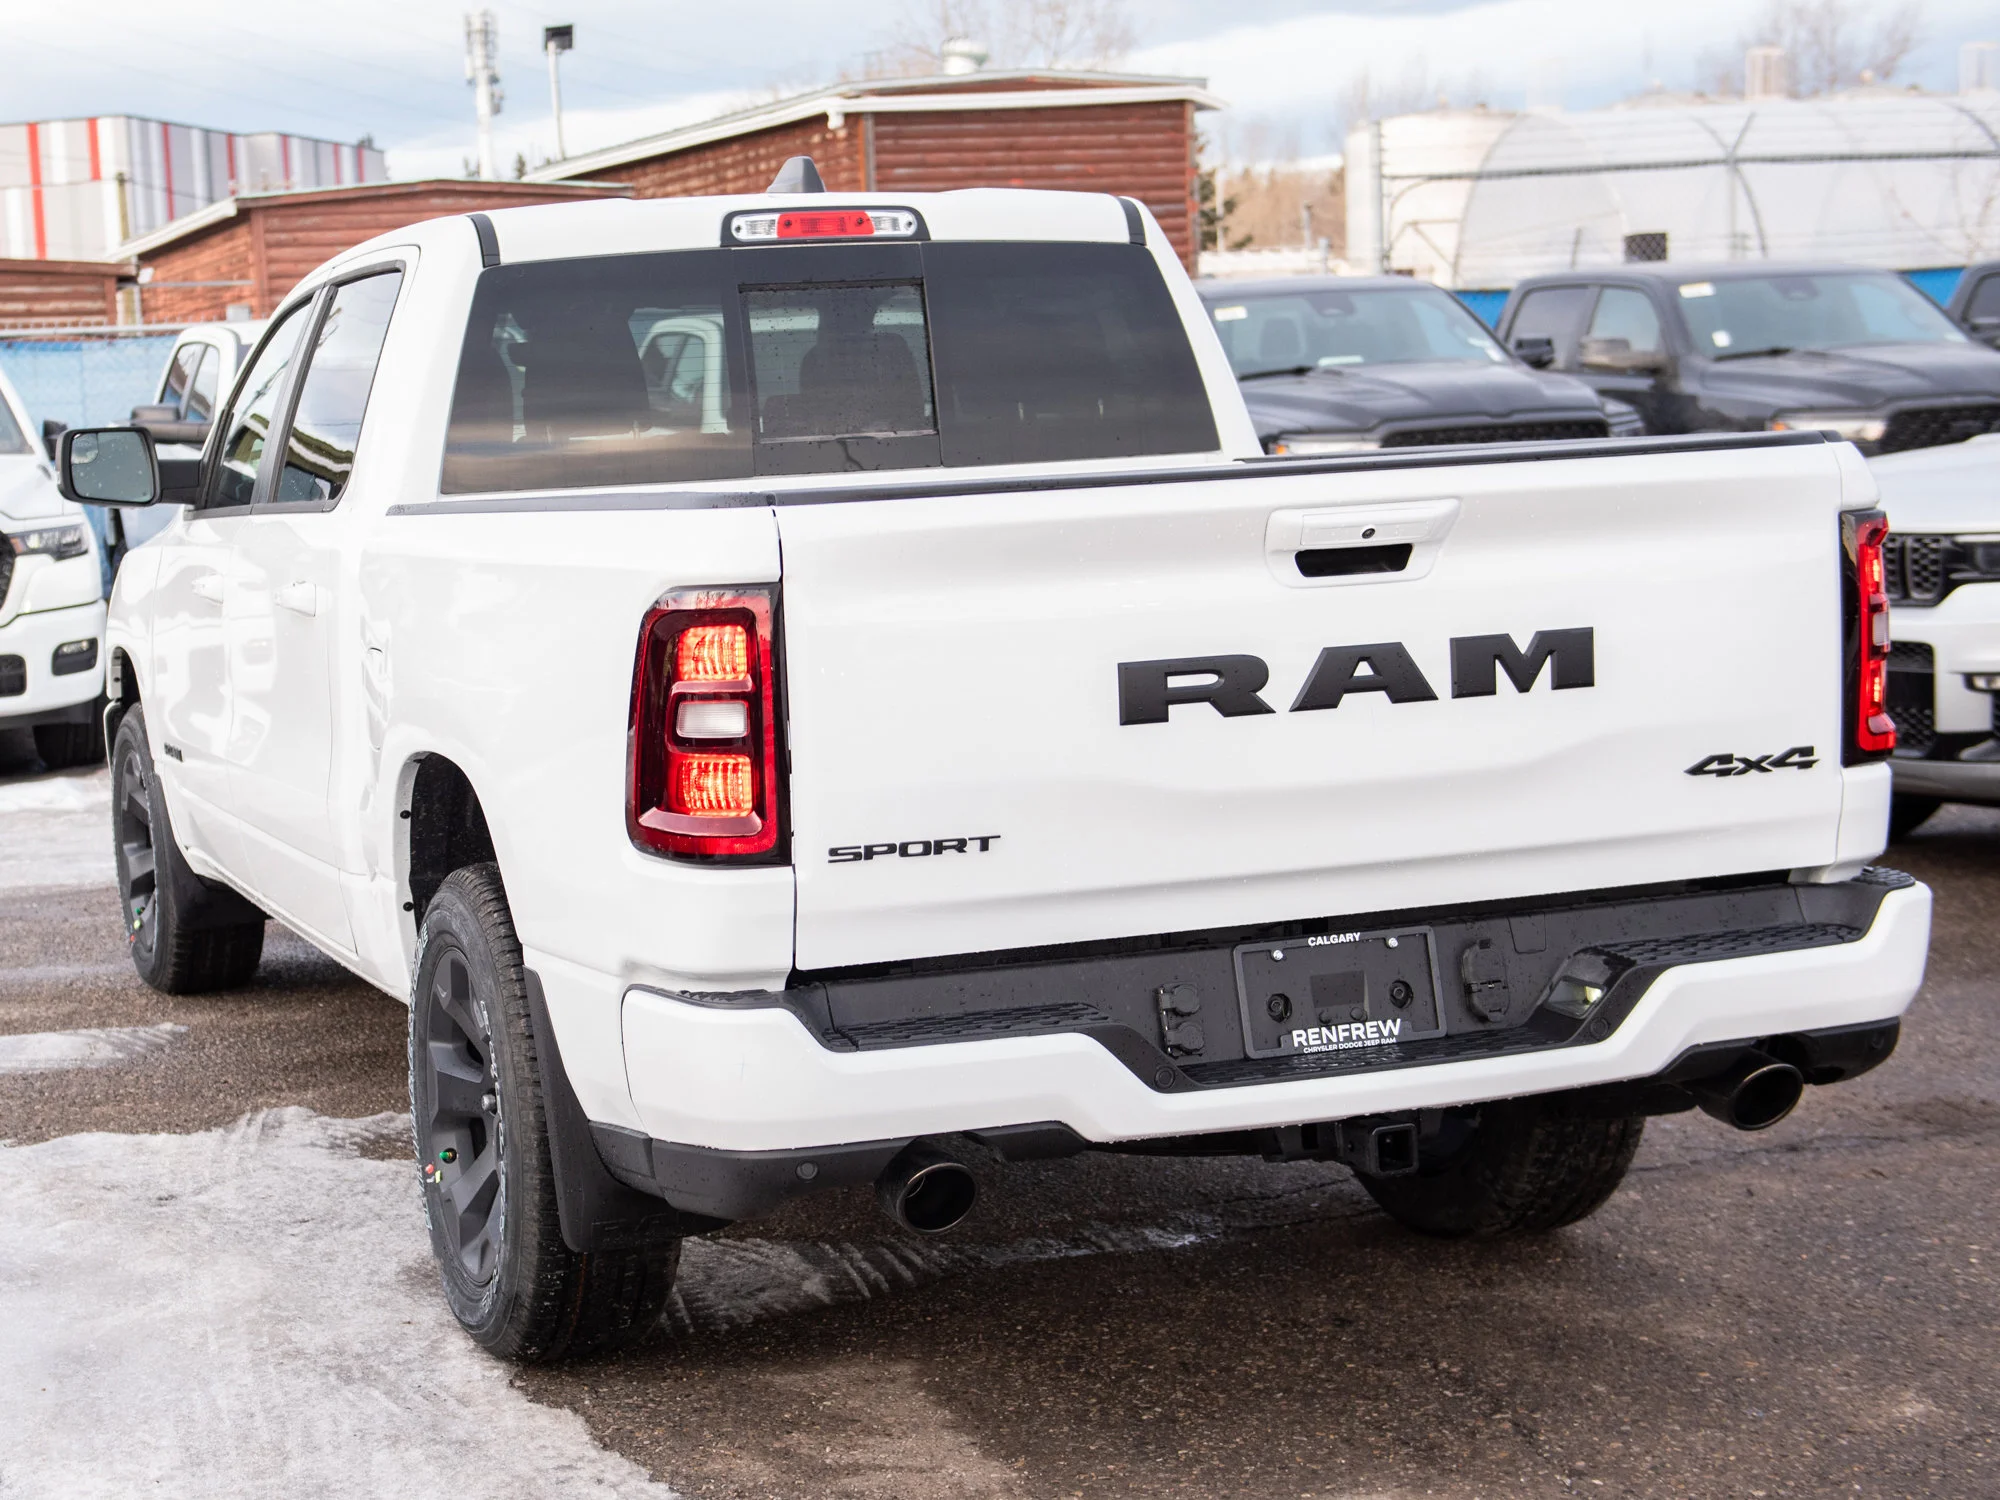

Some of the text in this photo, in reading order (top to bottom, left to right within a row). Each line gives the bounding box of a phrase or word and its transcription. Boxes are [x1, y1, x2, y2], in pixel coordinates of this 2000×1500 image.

[1118, 626, 1595, 726] RAM
[1683, 745, 1821, 778] 4x4
[827, 834, 1002, 864] SPORT
[1307, 932, 1361, 947] CALGARY
[1292, 1018, 1401, 1047] RENFREW
[1303, 1037, 1397, 1054] CHRYSLER DODGE JEEP RAM
